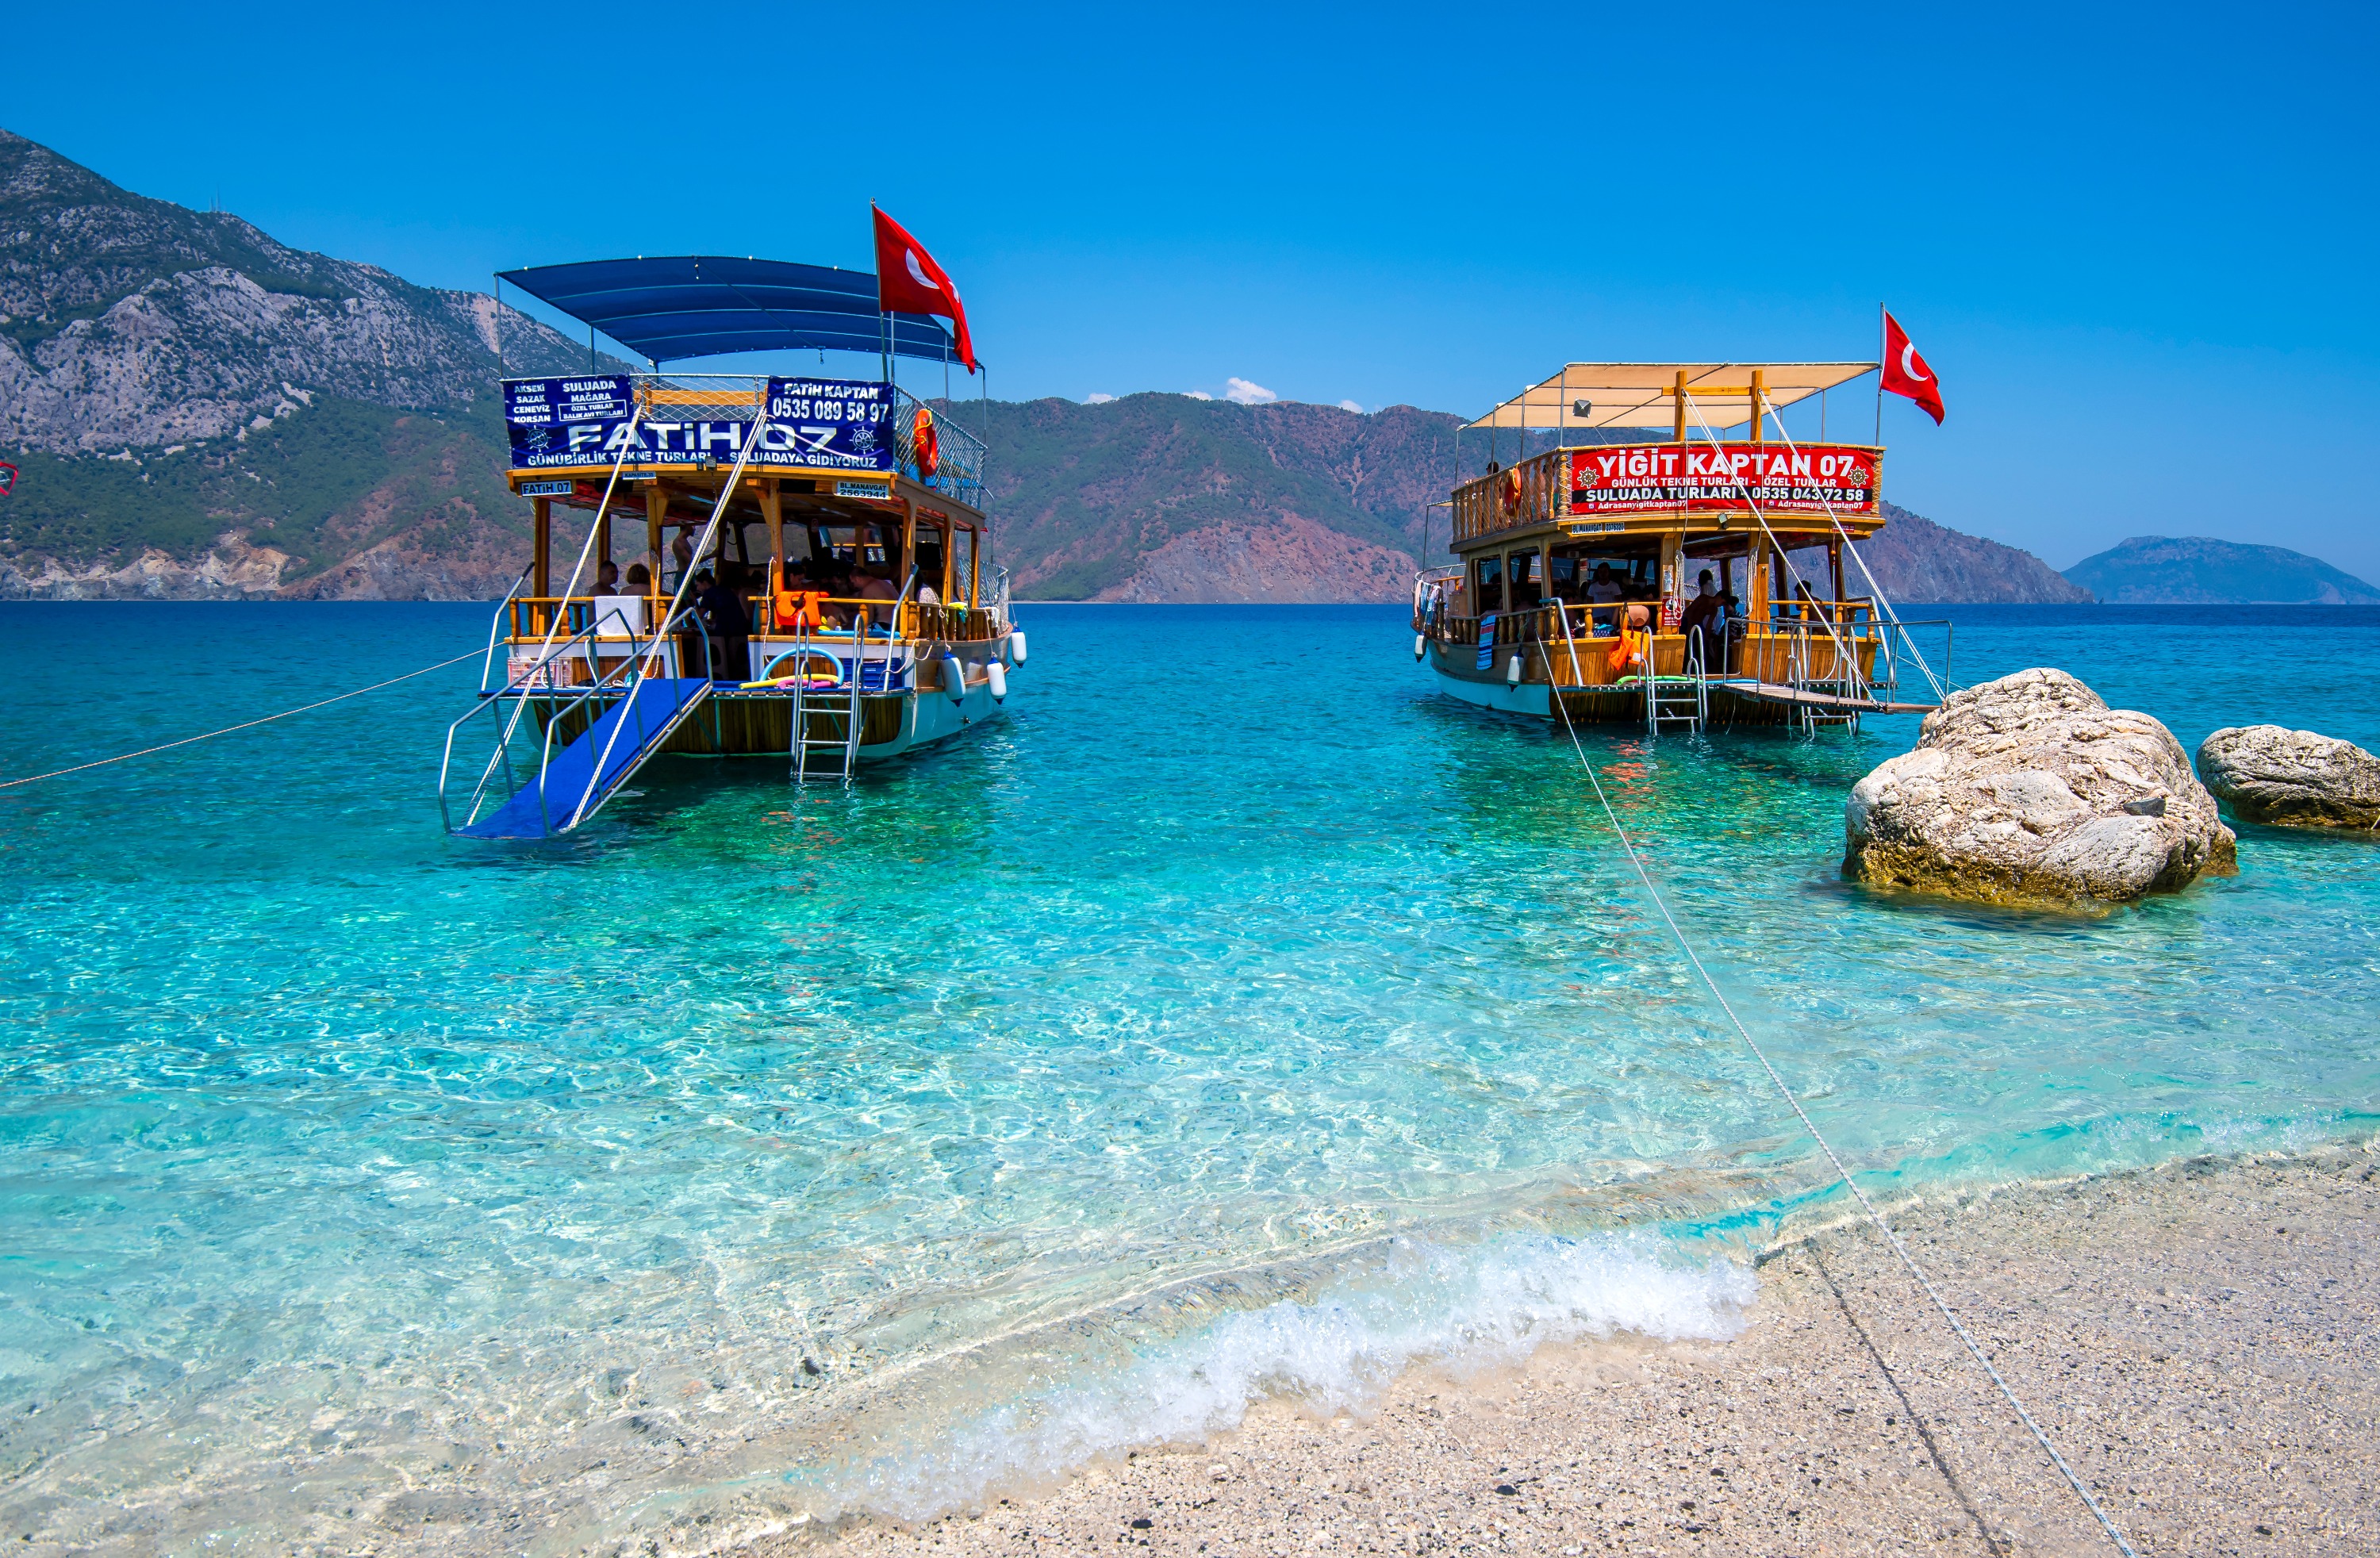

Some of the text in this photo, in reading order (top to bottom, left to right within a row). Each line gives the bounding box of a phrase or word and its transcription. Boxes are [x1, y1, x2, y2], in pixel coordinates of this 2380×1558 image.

[562, 380, 617, 393] SULUADA
[824, 386, 879, 400] KAPTAN
[570, 392, 612, 403] MAĞARA
[571, 403, 588, 412] ÖZEL
[773, 397, 889, 423] 0535 089 58 97
[758, 423, 837, 452] 07
[610, 451, 652, 464] TEKNE
[1597, 448, 1855, 478] YİĞİT KAPTAN 07
[555, 482, 570, 493] 07
[1611, 476, 1657, 488] GÜNLÜK
[1660, 478, 1699, 486] TEKNE
[1700, 477, 1749, 486] TURLARI
[1764, 475, 1791, 487] ÖZEL
[839, 489, 886, 499] 2563944
[1586, 486, 1663, 501] SULUADA
[1667, 486, 1736, 501] TURLARI
[1752, 486, 1789, 500] 0535
[1792, 488, 1820, 501] 043
[1825, 489, 1842, 501] 72
[1845, 489, 1864, 501] 58
